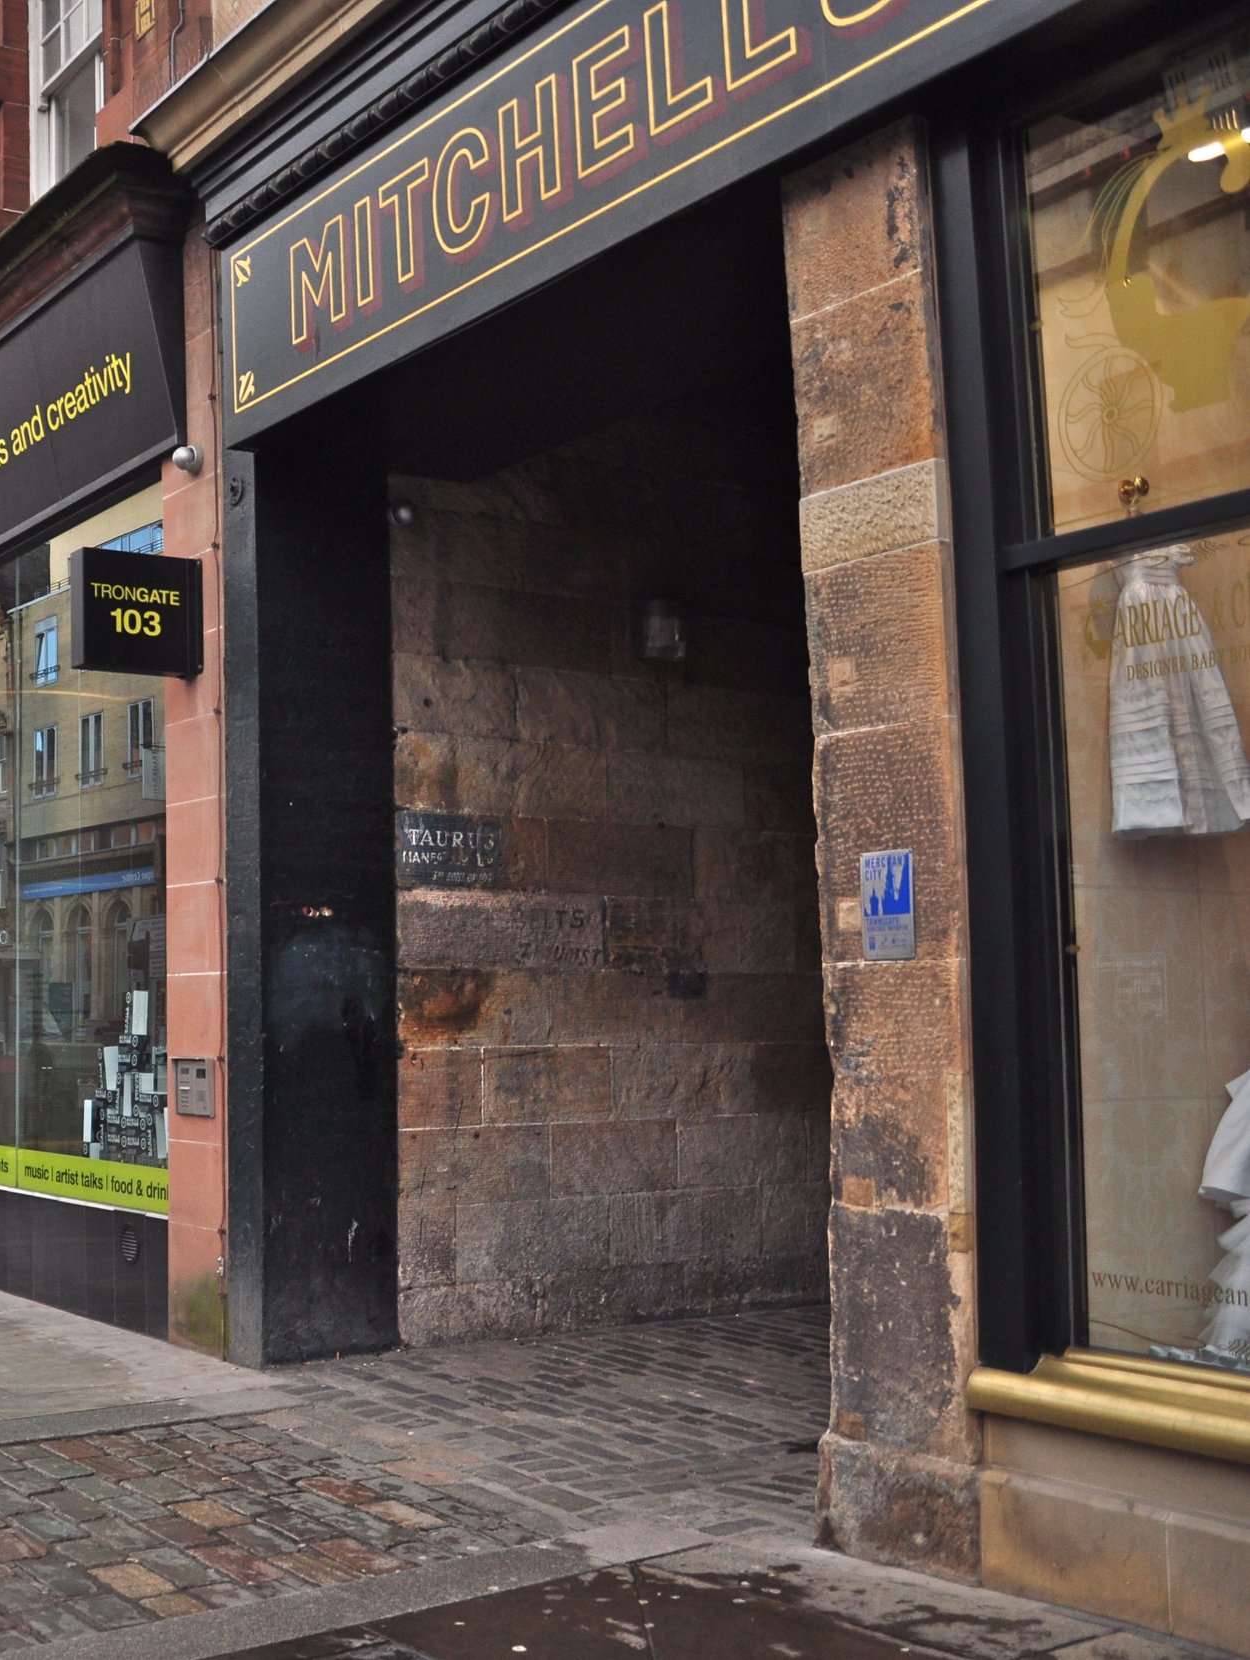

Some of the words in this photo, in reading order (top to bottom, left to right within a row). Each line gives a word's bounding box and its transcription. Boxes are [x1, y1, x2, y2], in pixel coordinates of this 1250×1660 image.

[290, 0, 892, 345] MITCHELL
[10, 404, 45, 455] and
[46, 352, 131, 431] creativity
[90, 582, 180, 606] TRONGATE
[110, 607, 161, 637] 103
[1127, 655, 1188, 681] DESIGNER
[865, 868, 882, 881] CITY
[24, 1164, 49, 1181] music
[55, 1169, 79, 1186] artist
[81, 1171, 103, 1190] talks
[111, 1175, 133, 1195] food
[135, 1180, 143, 1196] &
